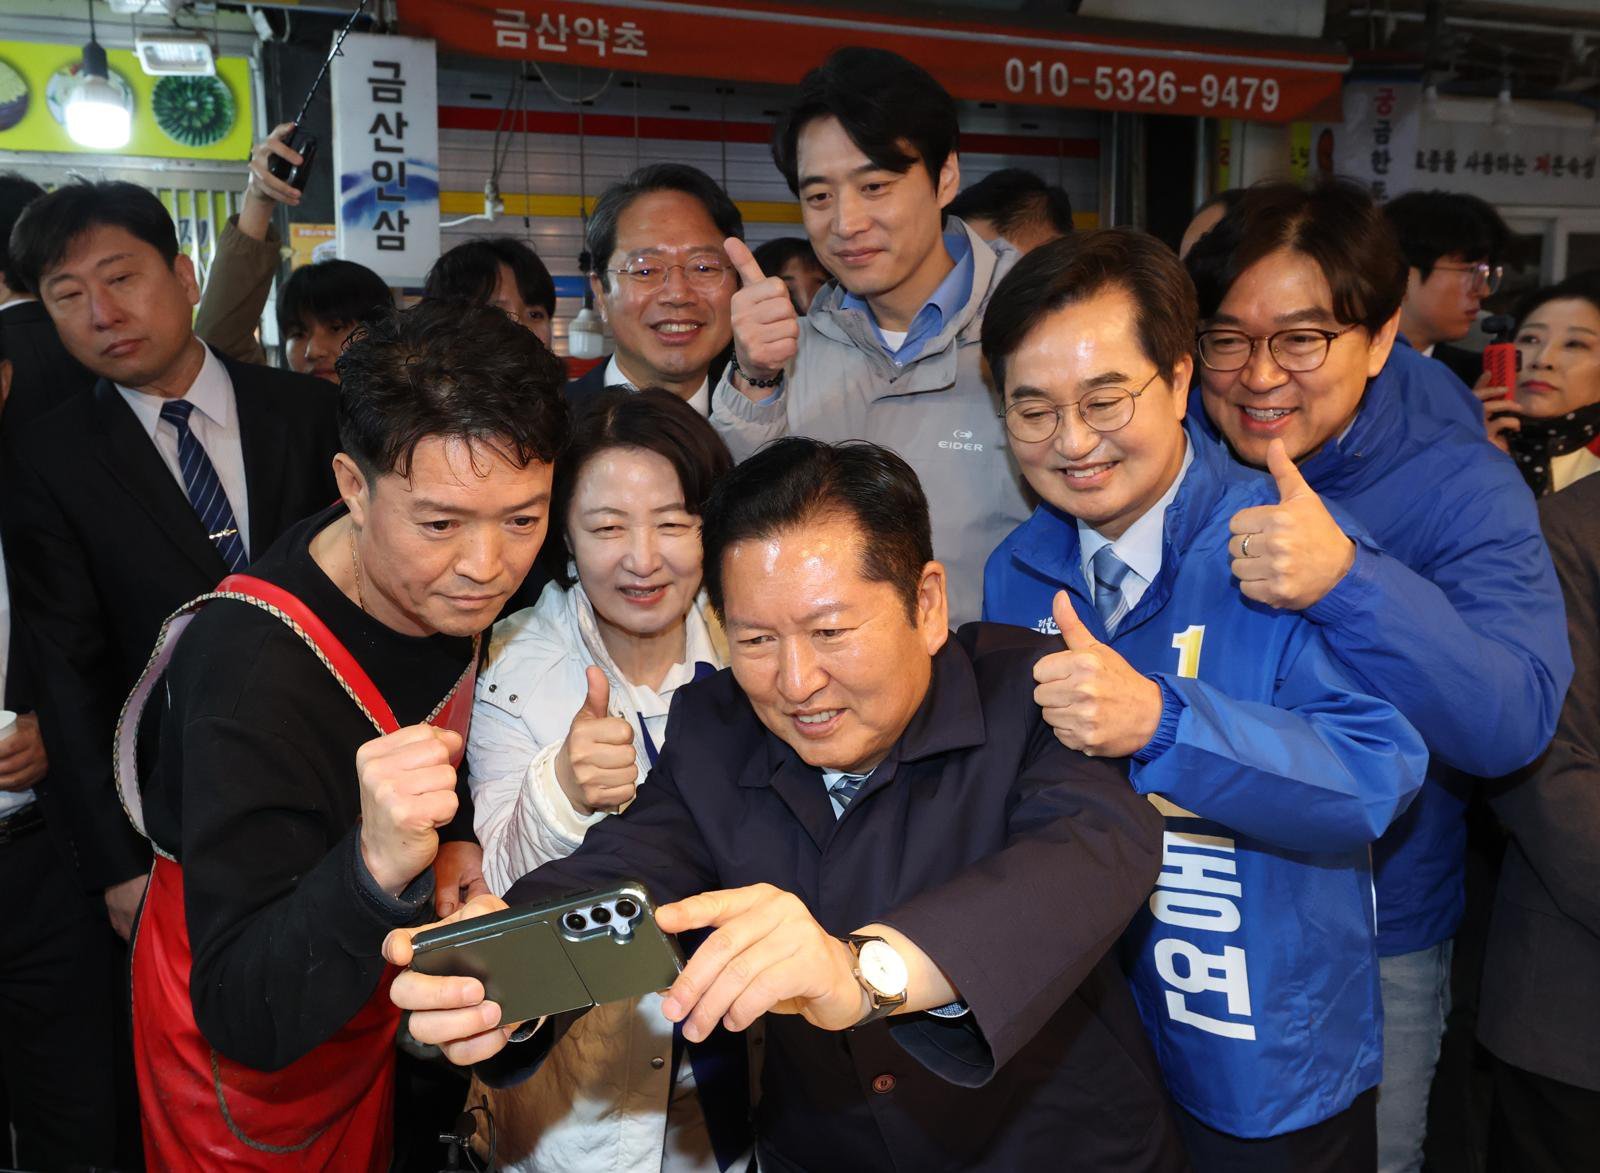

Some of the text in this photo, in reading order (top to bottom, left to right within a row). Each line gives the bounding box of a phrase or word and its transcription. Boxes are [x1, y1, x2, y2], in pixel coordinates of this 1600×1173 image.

[493, 9, 648, 58] 금산약초
[1004, 57, 1281, 113] 010-5326-9479
[367, 60, 411, 252] 금산인삼
[937, 440, 984, 452] EIDER
[1171, 624, 1206, 678] 1
[1147, 793, 1257, 1041] 동연
